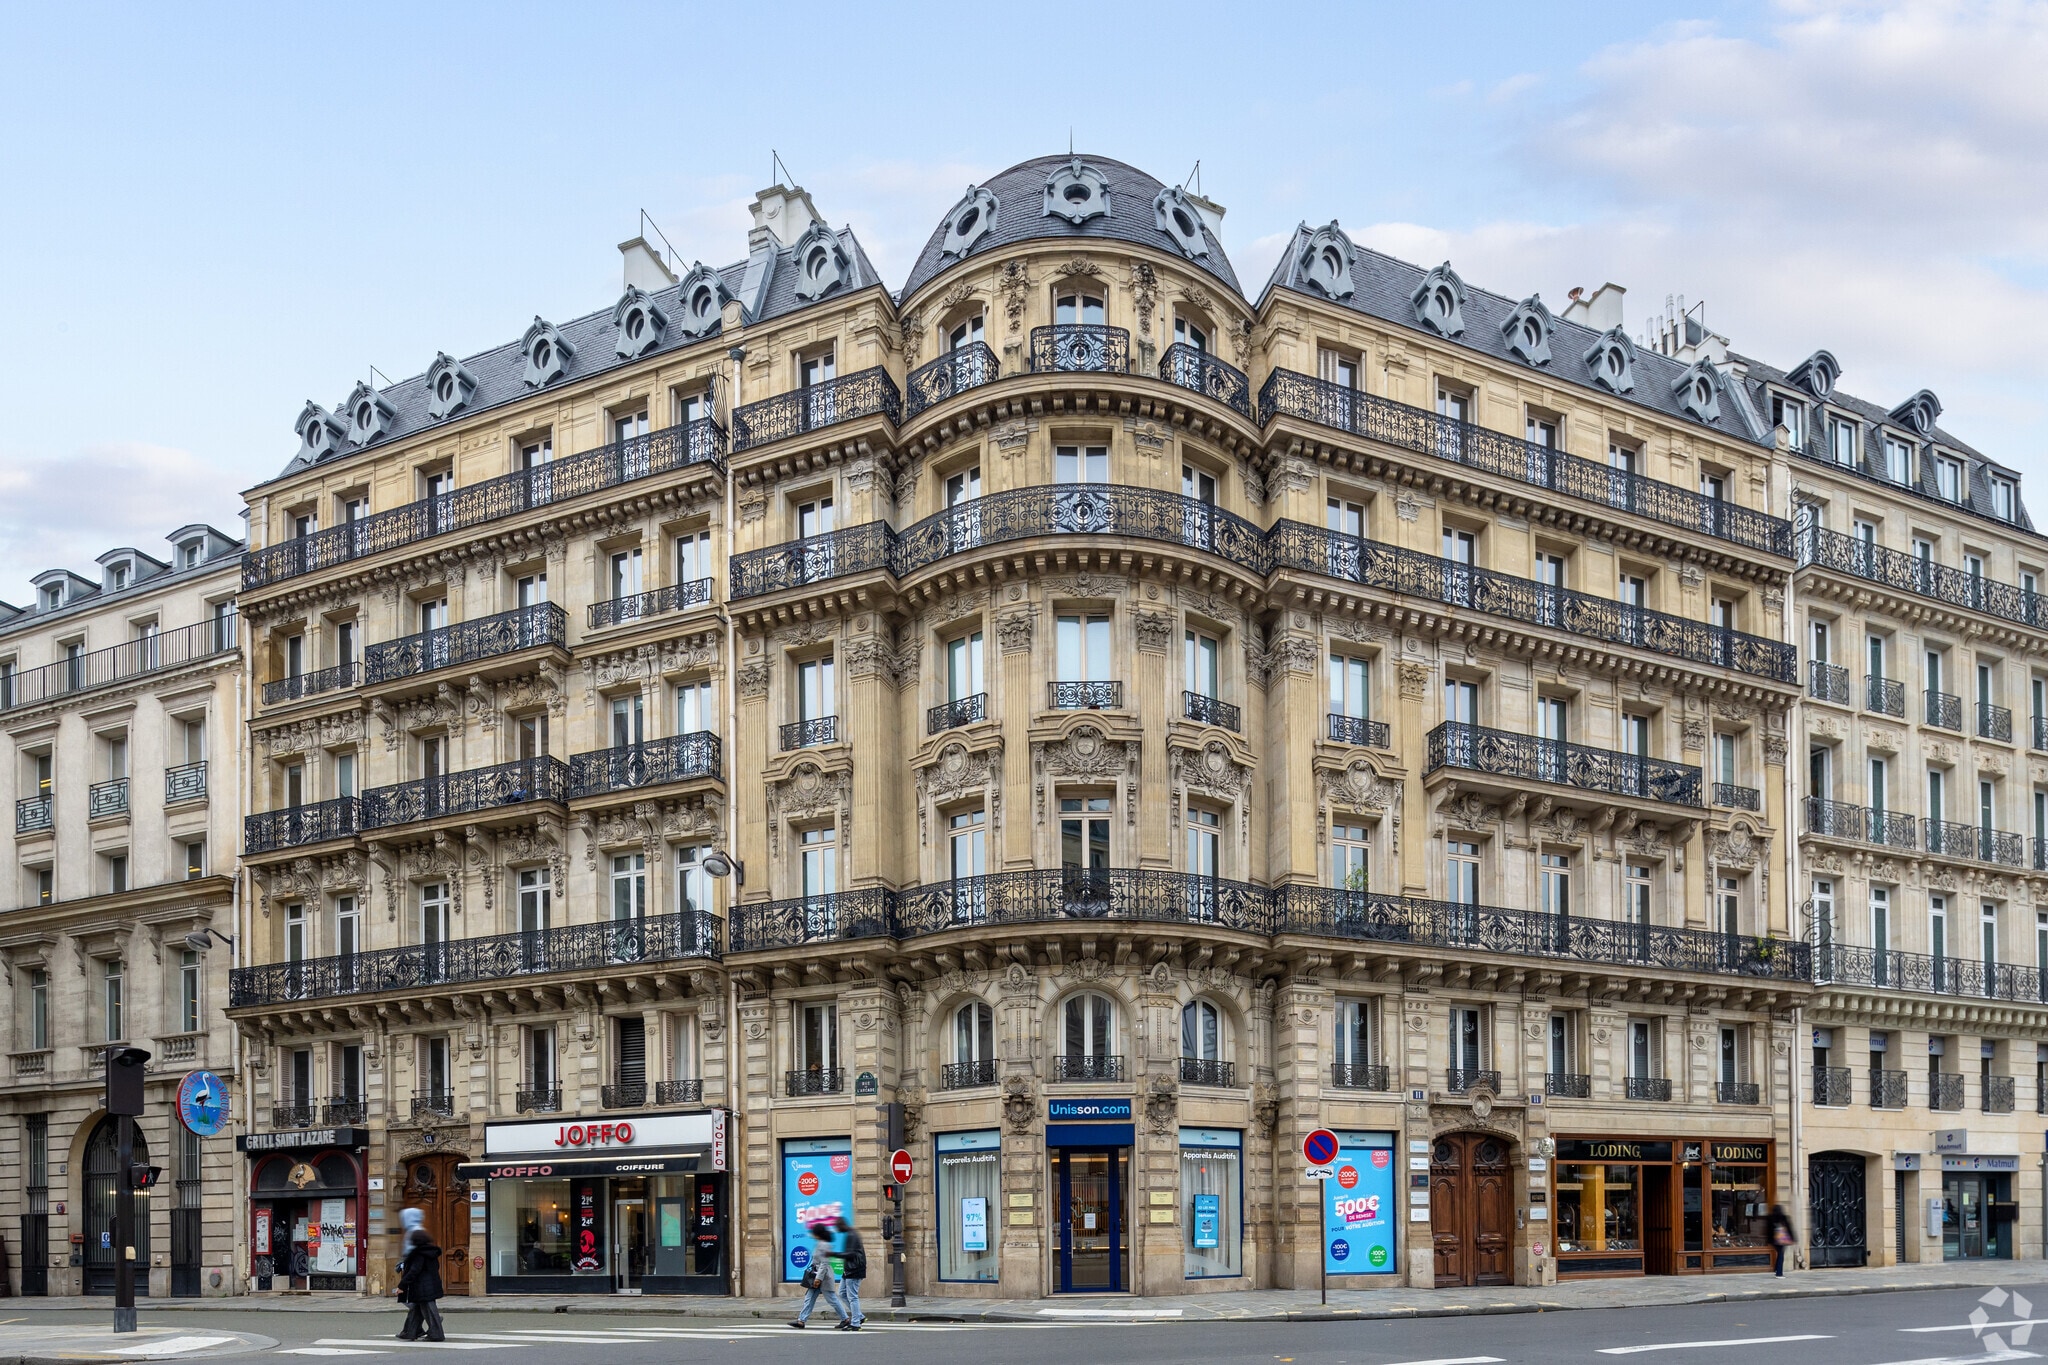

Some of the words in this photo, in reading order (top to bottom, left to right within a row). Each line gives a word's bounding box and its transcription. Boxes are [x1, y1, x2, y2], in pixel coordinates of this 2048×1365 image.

[1050, 1104, 1130, 1115] Unisson.com
[246, 1134, 275, 1149] GRILL
[275, 1132, 300, 1147] SAINT
[301, 1130, 336, 1146] LAZARE
[554, 1122, 633, 1147] JOFFO
[715, 1123, 724, 1166] JOFFO
[1183, 1151, 1212, 1160] Appareils
[1213, 1152, 1236, 1160] Auditifs
[1716, 1146, 1762, 1159] LODING
[942, 1156, 971, 1166] Appareils
[972, 1154, 996, 1163] Auditifs
[1987, 1160, 2014, 1168] Matmut
[490, 1165, 552, 1178] JOFFO
[615, 1163, 664, 1171] COIFFURE
[1335, 1195, 1380, 1217] 500€
[966, 1213, 982, 1221] 97%
